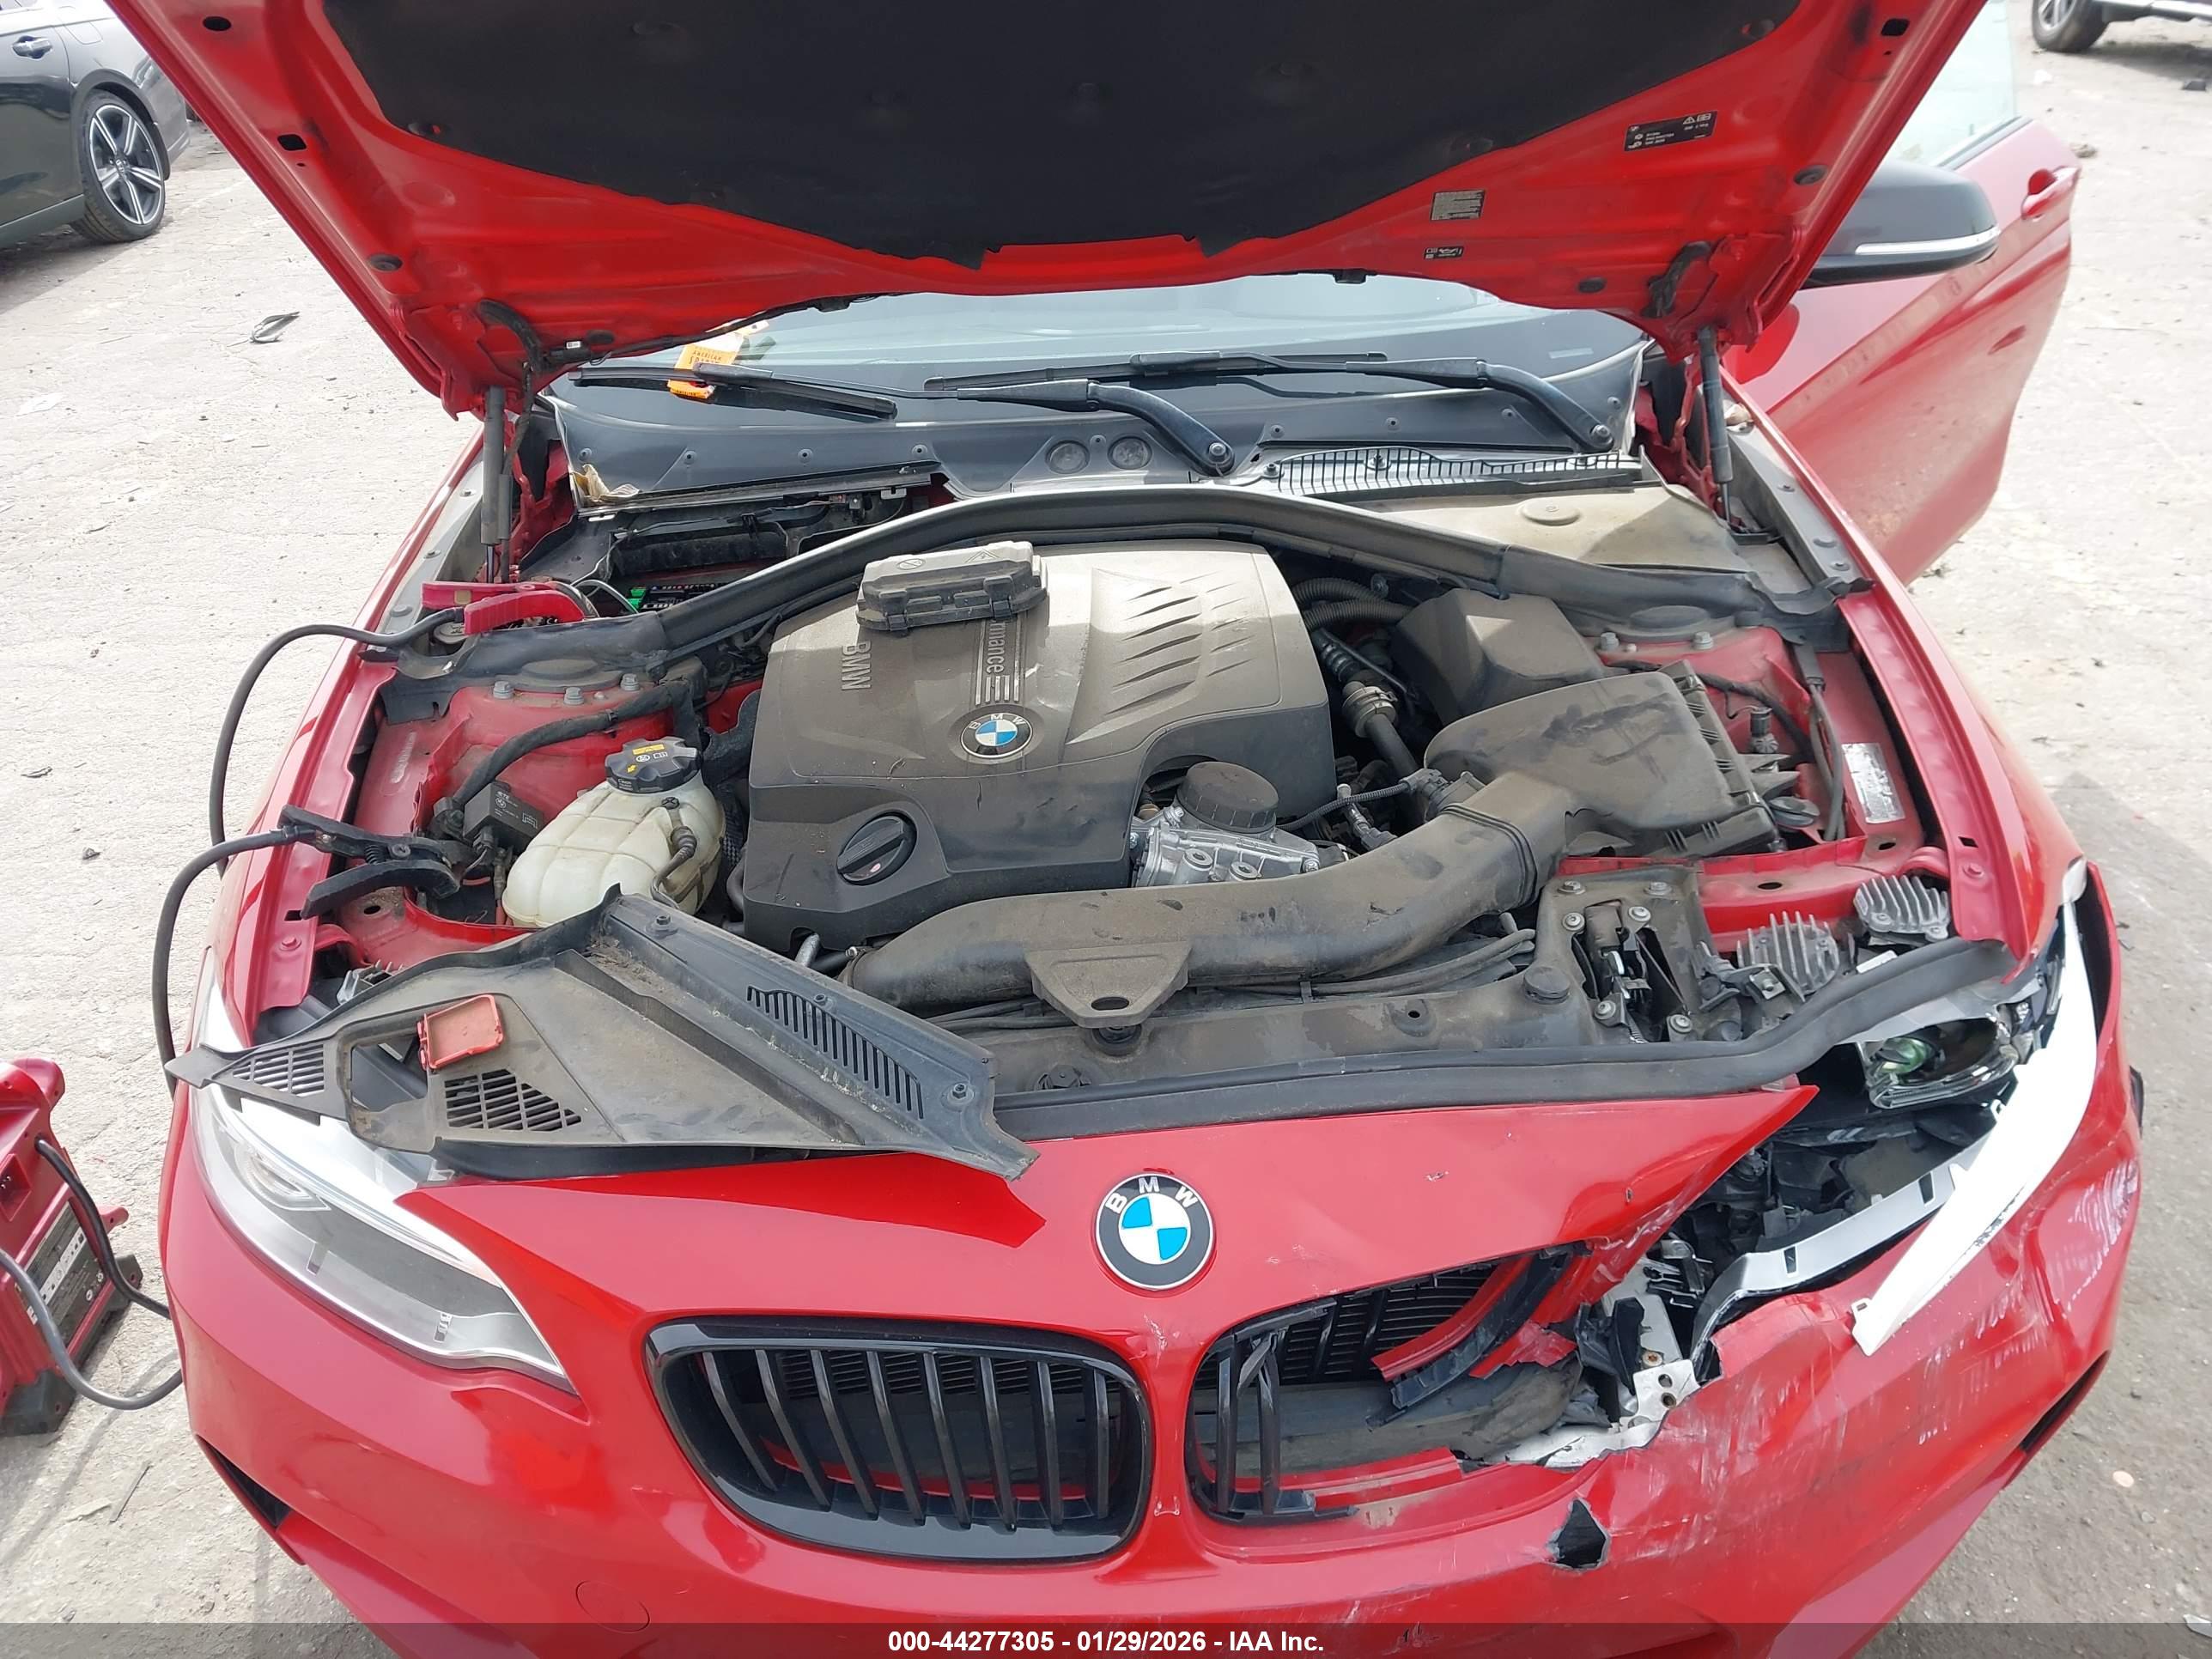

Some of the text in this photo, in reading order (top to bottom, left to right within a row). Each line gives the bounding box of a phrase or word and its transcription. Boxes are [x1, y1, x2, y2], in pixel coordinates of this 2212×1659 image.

[842, 640, 872, 690] BMW
[986, 618, 1006, 674] rmance
[968, 713, 1026, 730] BMW
[1104, 1176, 1200, 1214] BMW
